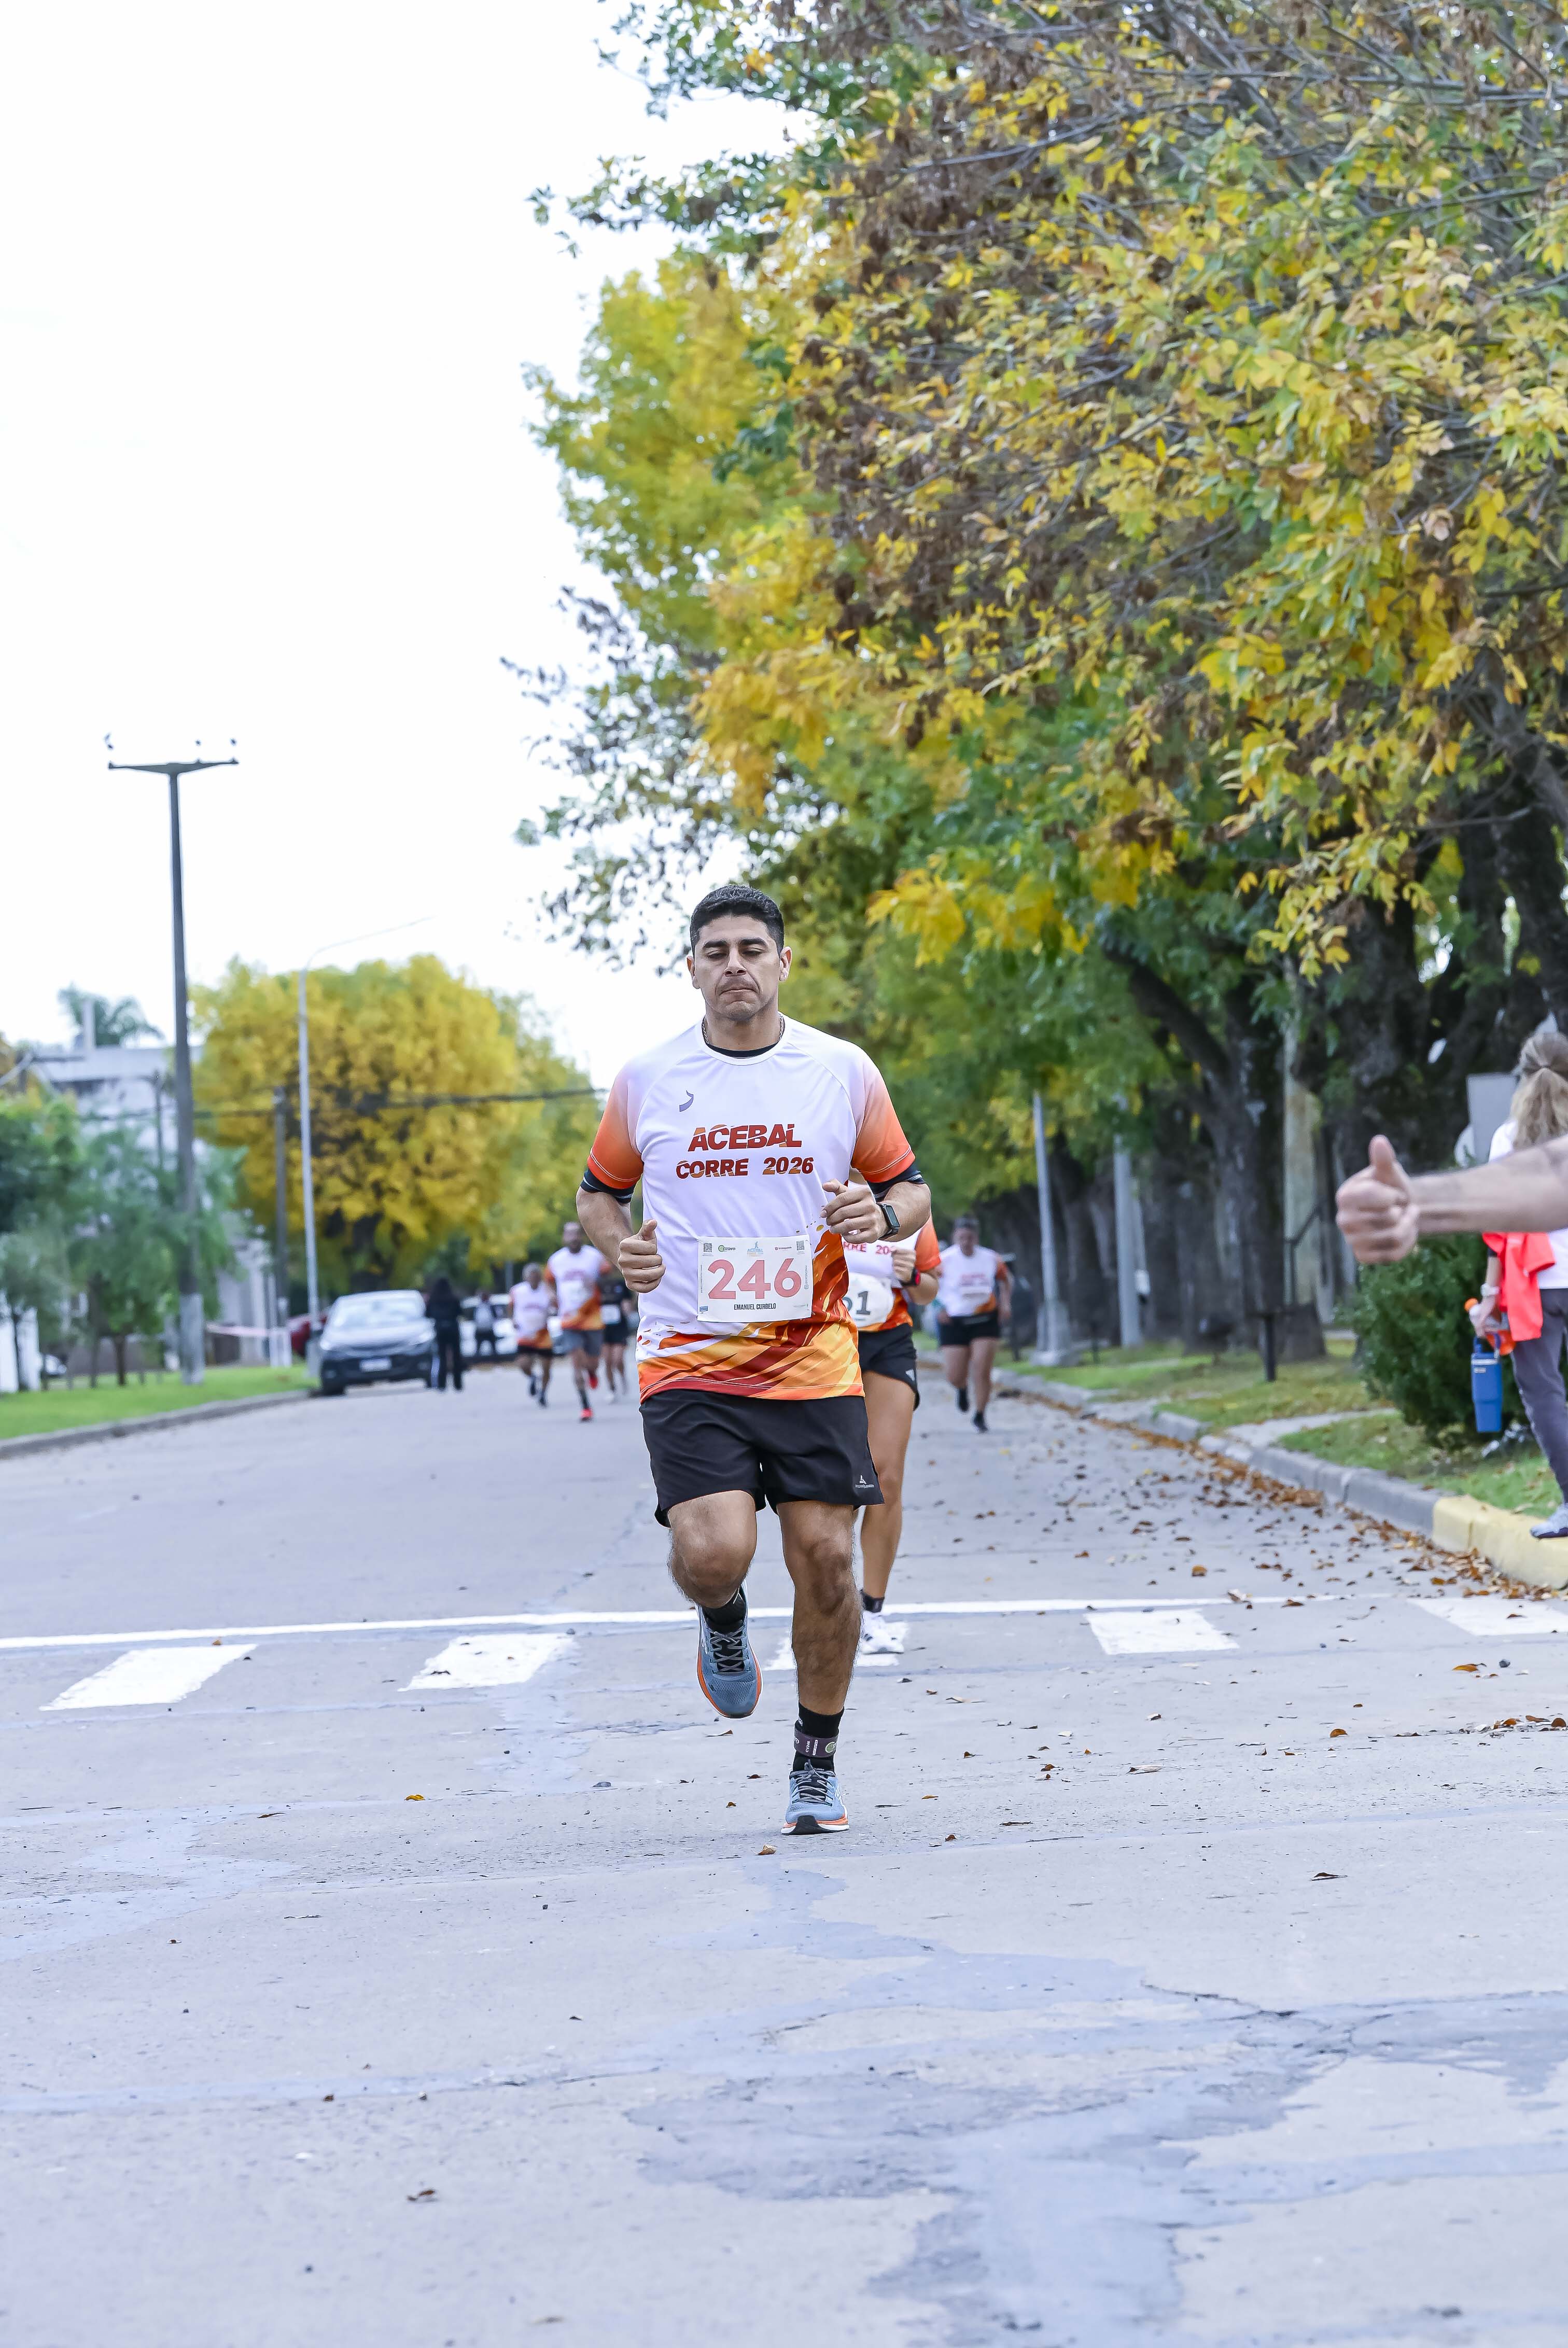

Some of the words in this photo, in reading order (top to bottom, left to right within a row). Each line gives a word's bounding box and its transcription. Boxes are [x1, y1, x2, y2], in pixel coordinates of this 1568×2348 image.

[688, 1124, 802, 1152] ACEBAL
[676, 1158, 749, 1179] CORRE
[762, 1157, 814, 1175] 2026
[708, 1258, 802, 1299] 246
